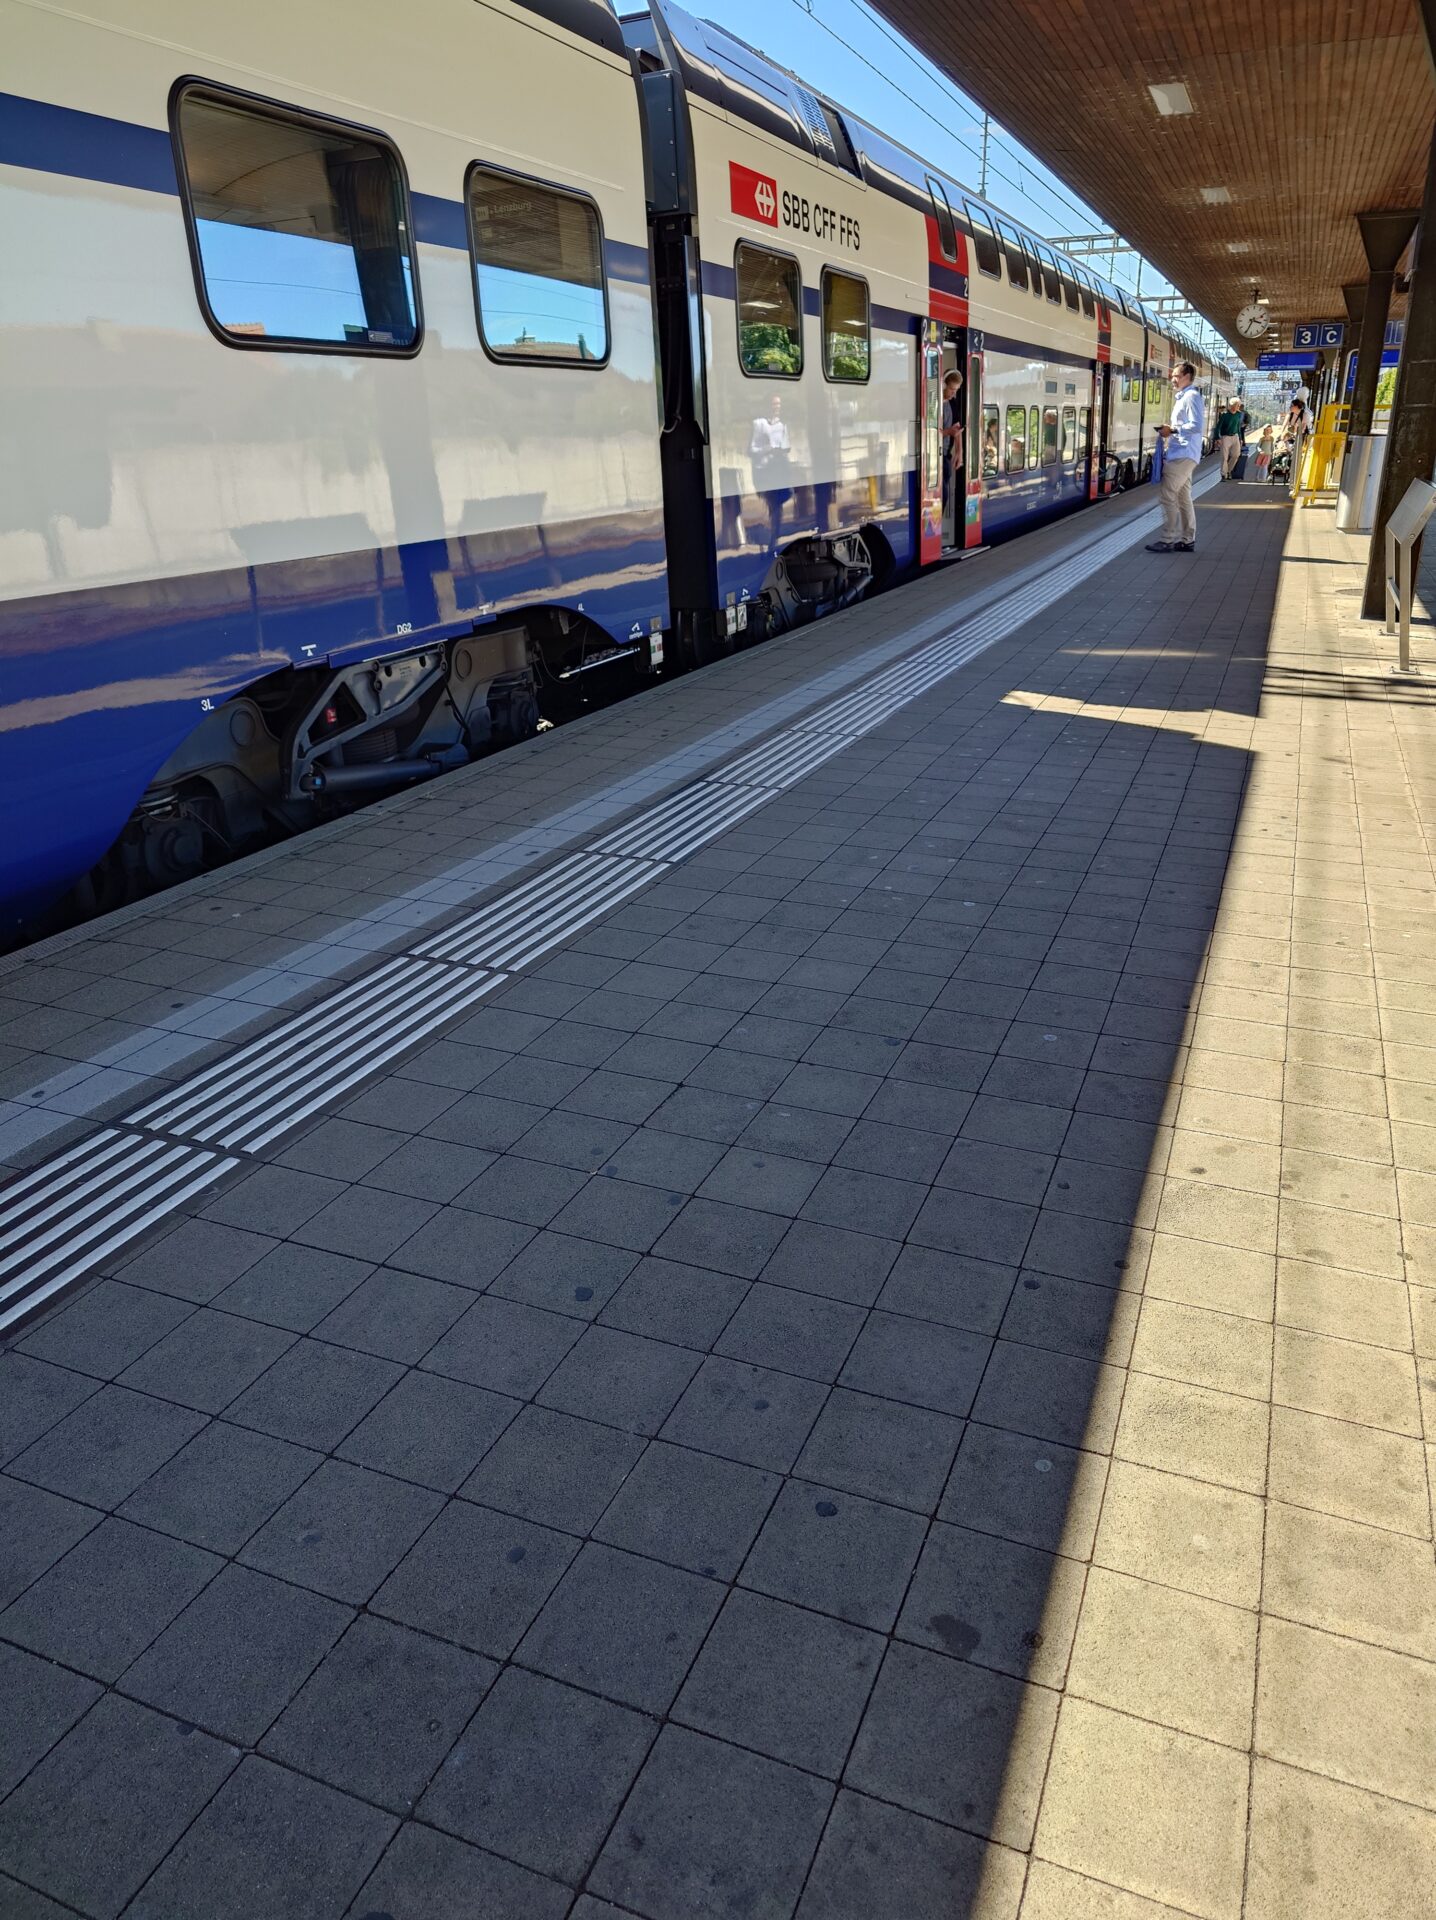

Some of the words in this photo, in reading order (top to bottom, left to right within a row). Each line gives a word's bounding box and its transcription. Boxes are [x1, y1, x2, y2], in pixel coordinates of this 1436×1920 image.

[782, 190, 810, 232] SBB
[813, 203, 836, 241] CFF
[839, 215, 861, 251] FFS
[963, 277, 968, 297] 2
[922, 318, 928, 341] 2
[1301, 331, 1312, 344] 3
[1326, 330, 1337, 344] C
[396, 622, 412, 634] DG2
[200, 698, 215, 712] 3L
